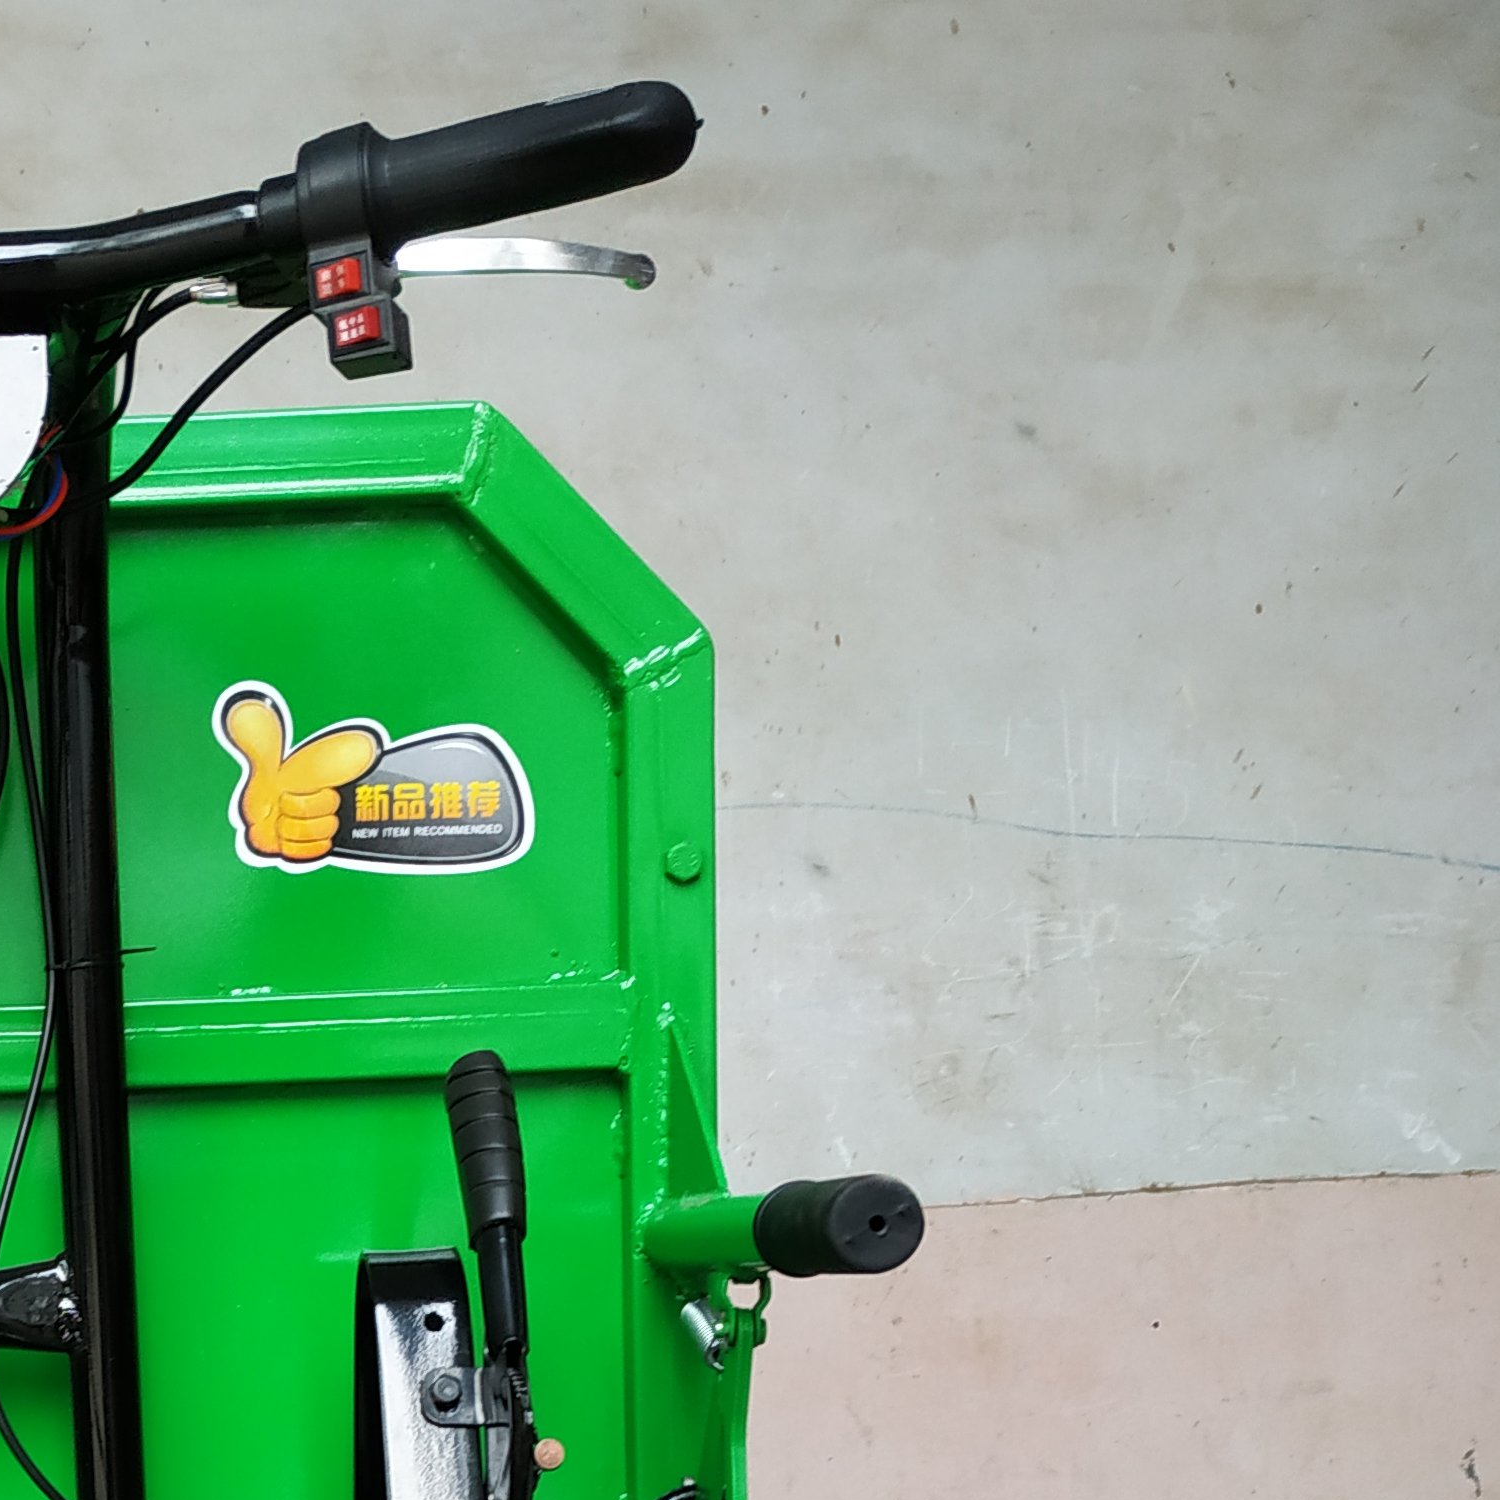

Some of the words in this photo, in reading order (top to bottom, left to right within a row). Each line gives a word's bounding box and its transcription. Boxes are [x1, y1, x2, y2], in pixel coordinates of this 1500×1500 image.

[355, 780, 500, 822] 新品推荐
[352, 828, 379, 839] NEW
[382, 827, 410, 838] ITEM
[413, 824, 503, 837] RECOMMENDED
